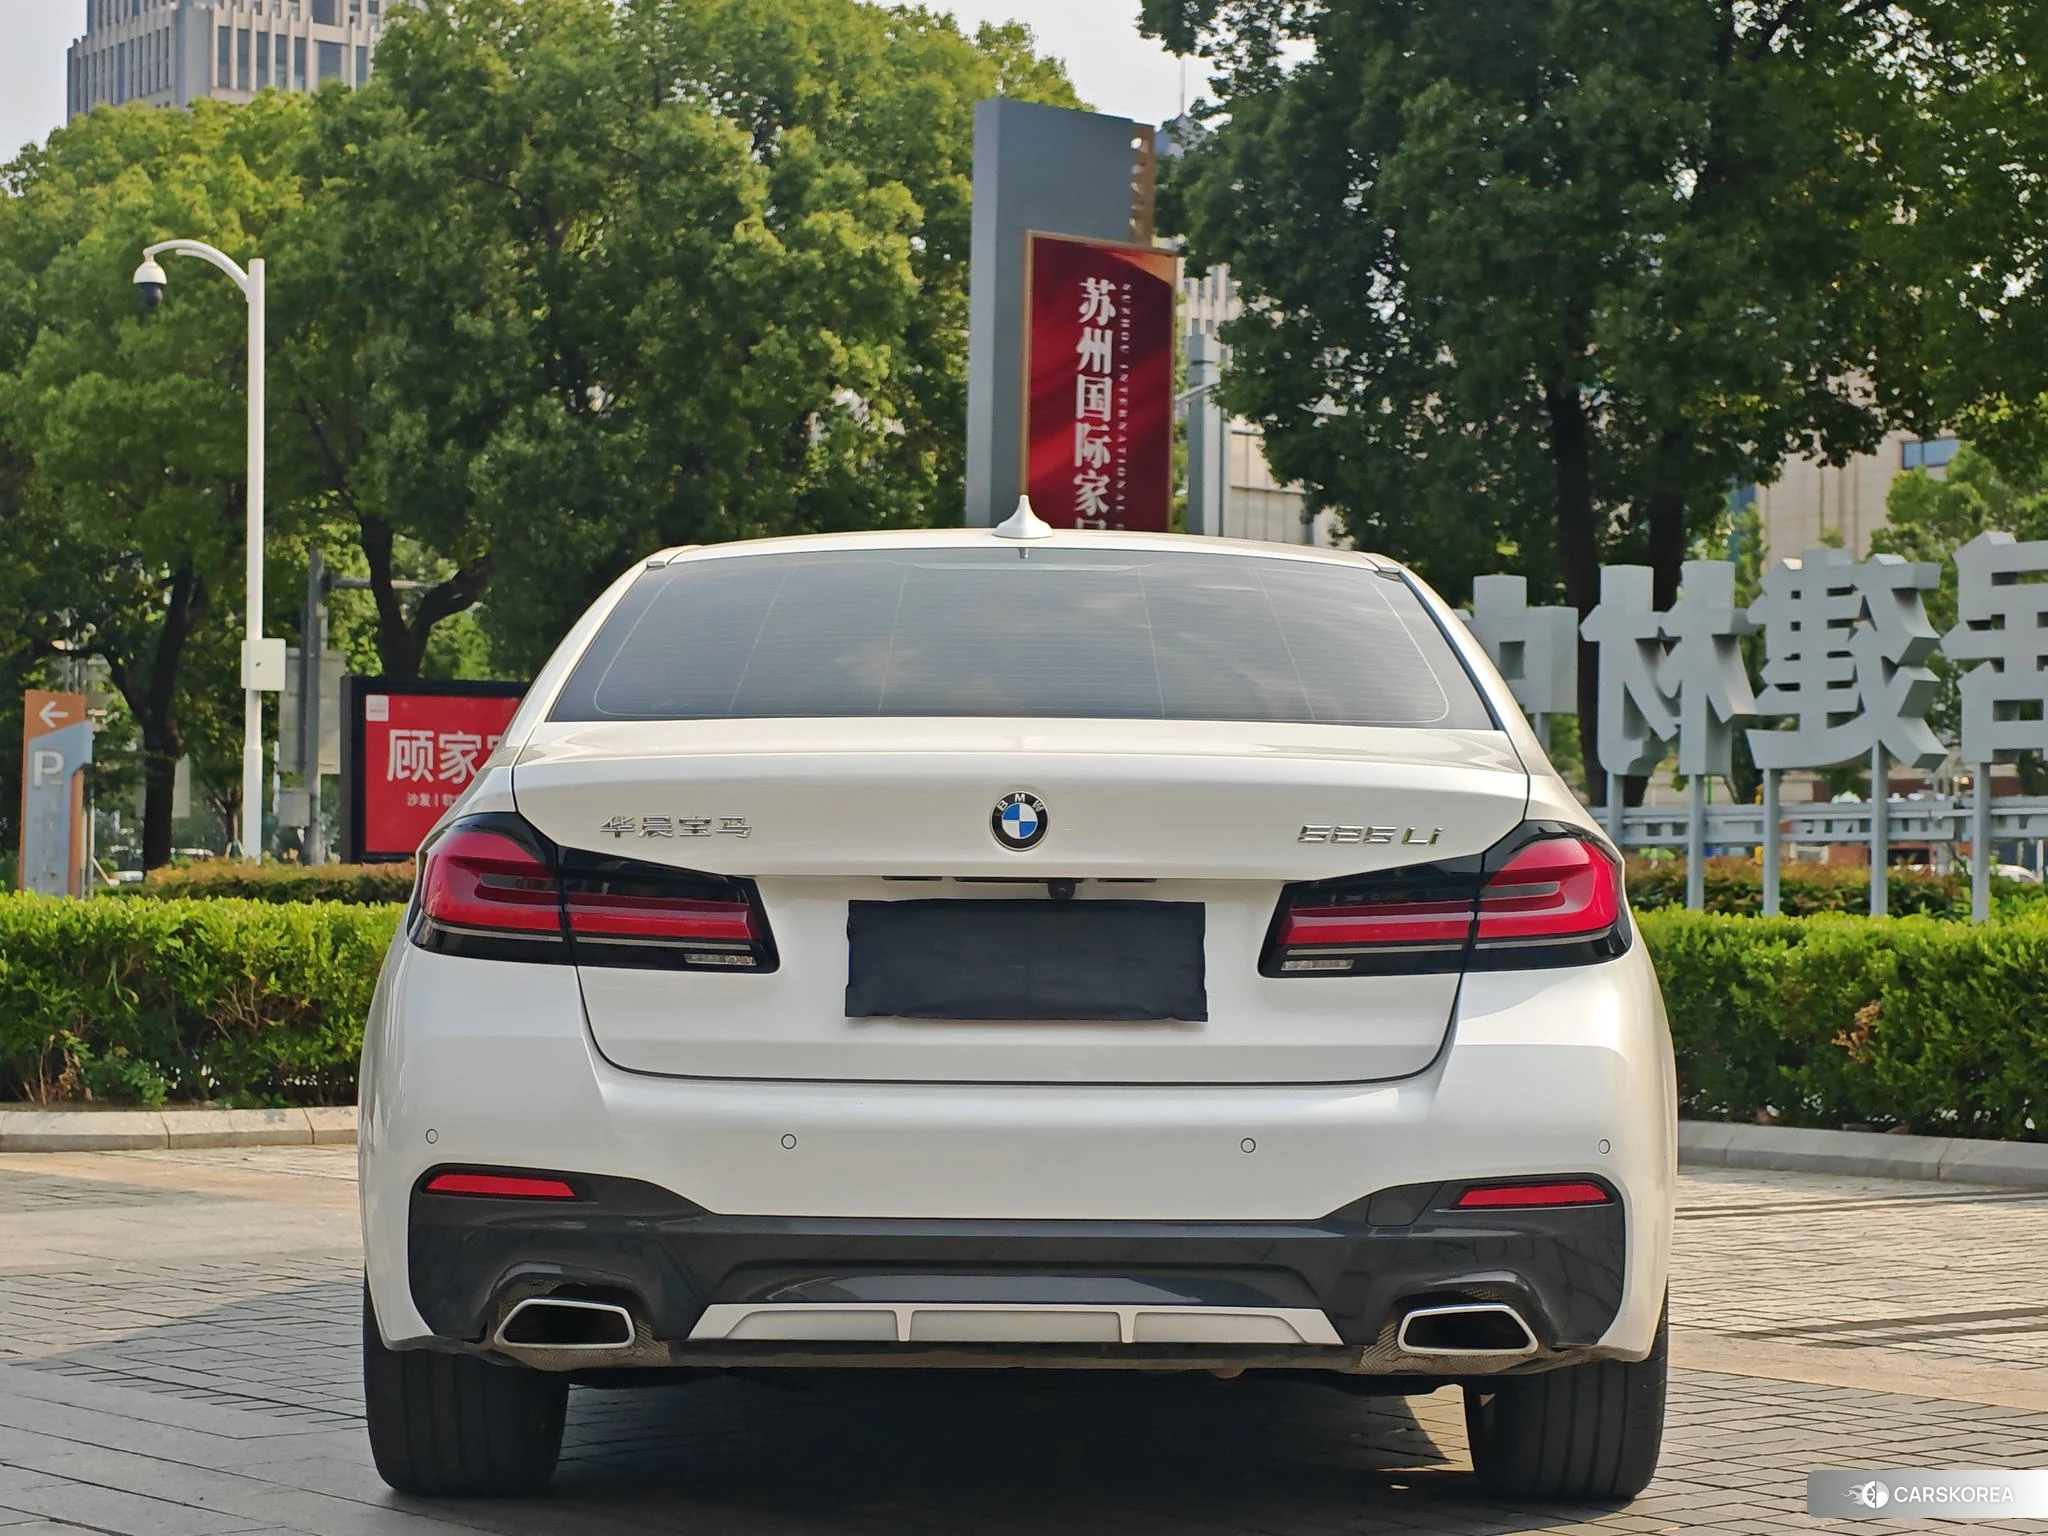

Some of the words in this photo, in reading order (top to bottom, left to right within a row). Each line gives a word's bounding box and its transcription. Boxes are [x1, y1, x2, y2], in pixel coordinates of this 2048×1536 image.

[1120, 283, 1132, 354] SUZHOU
[1115, 364, 1130, 512] INTERNATIONAL
[33, 750, 65, 789] P
[997, 793, 1045, 812] BMW
[599, 814, 752, 839] 华晨宝马
